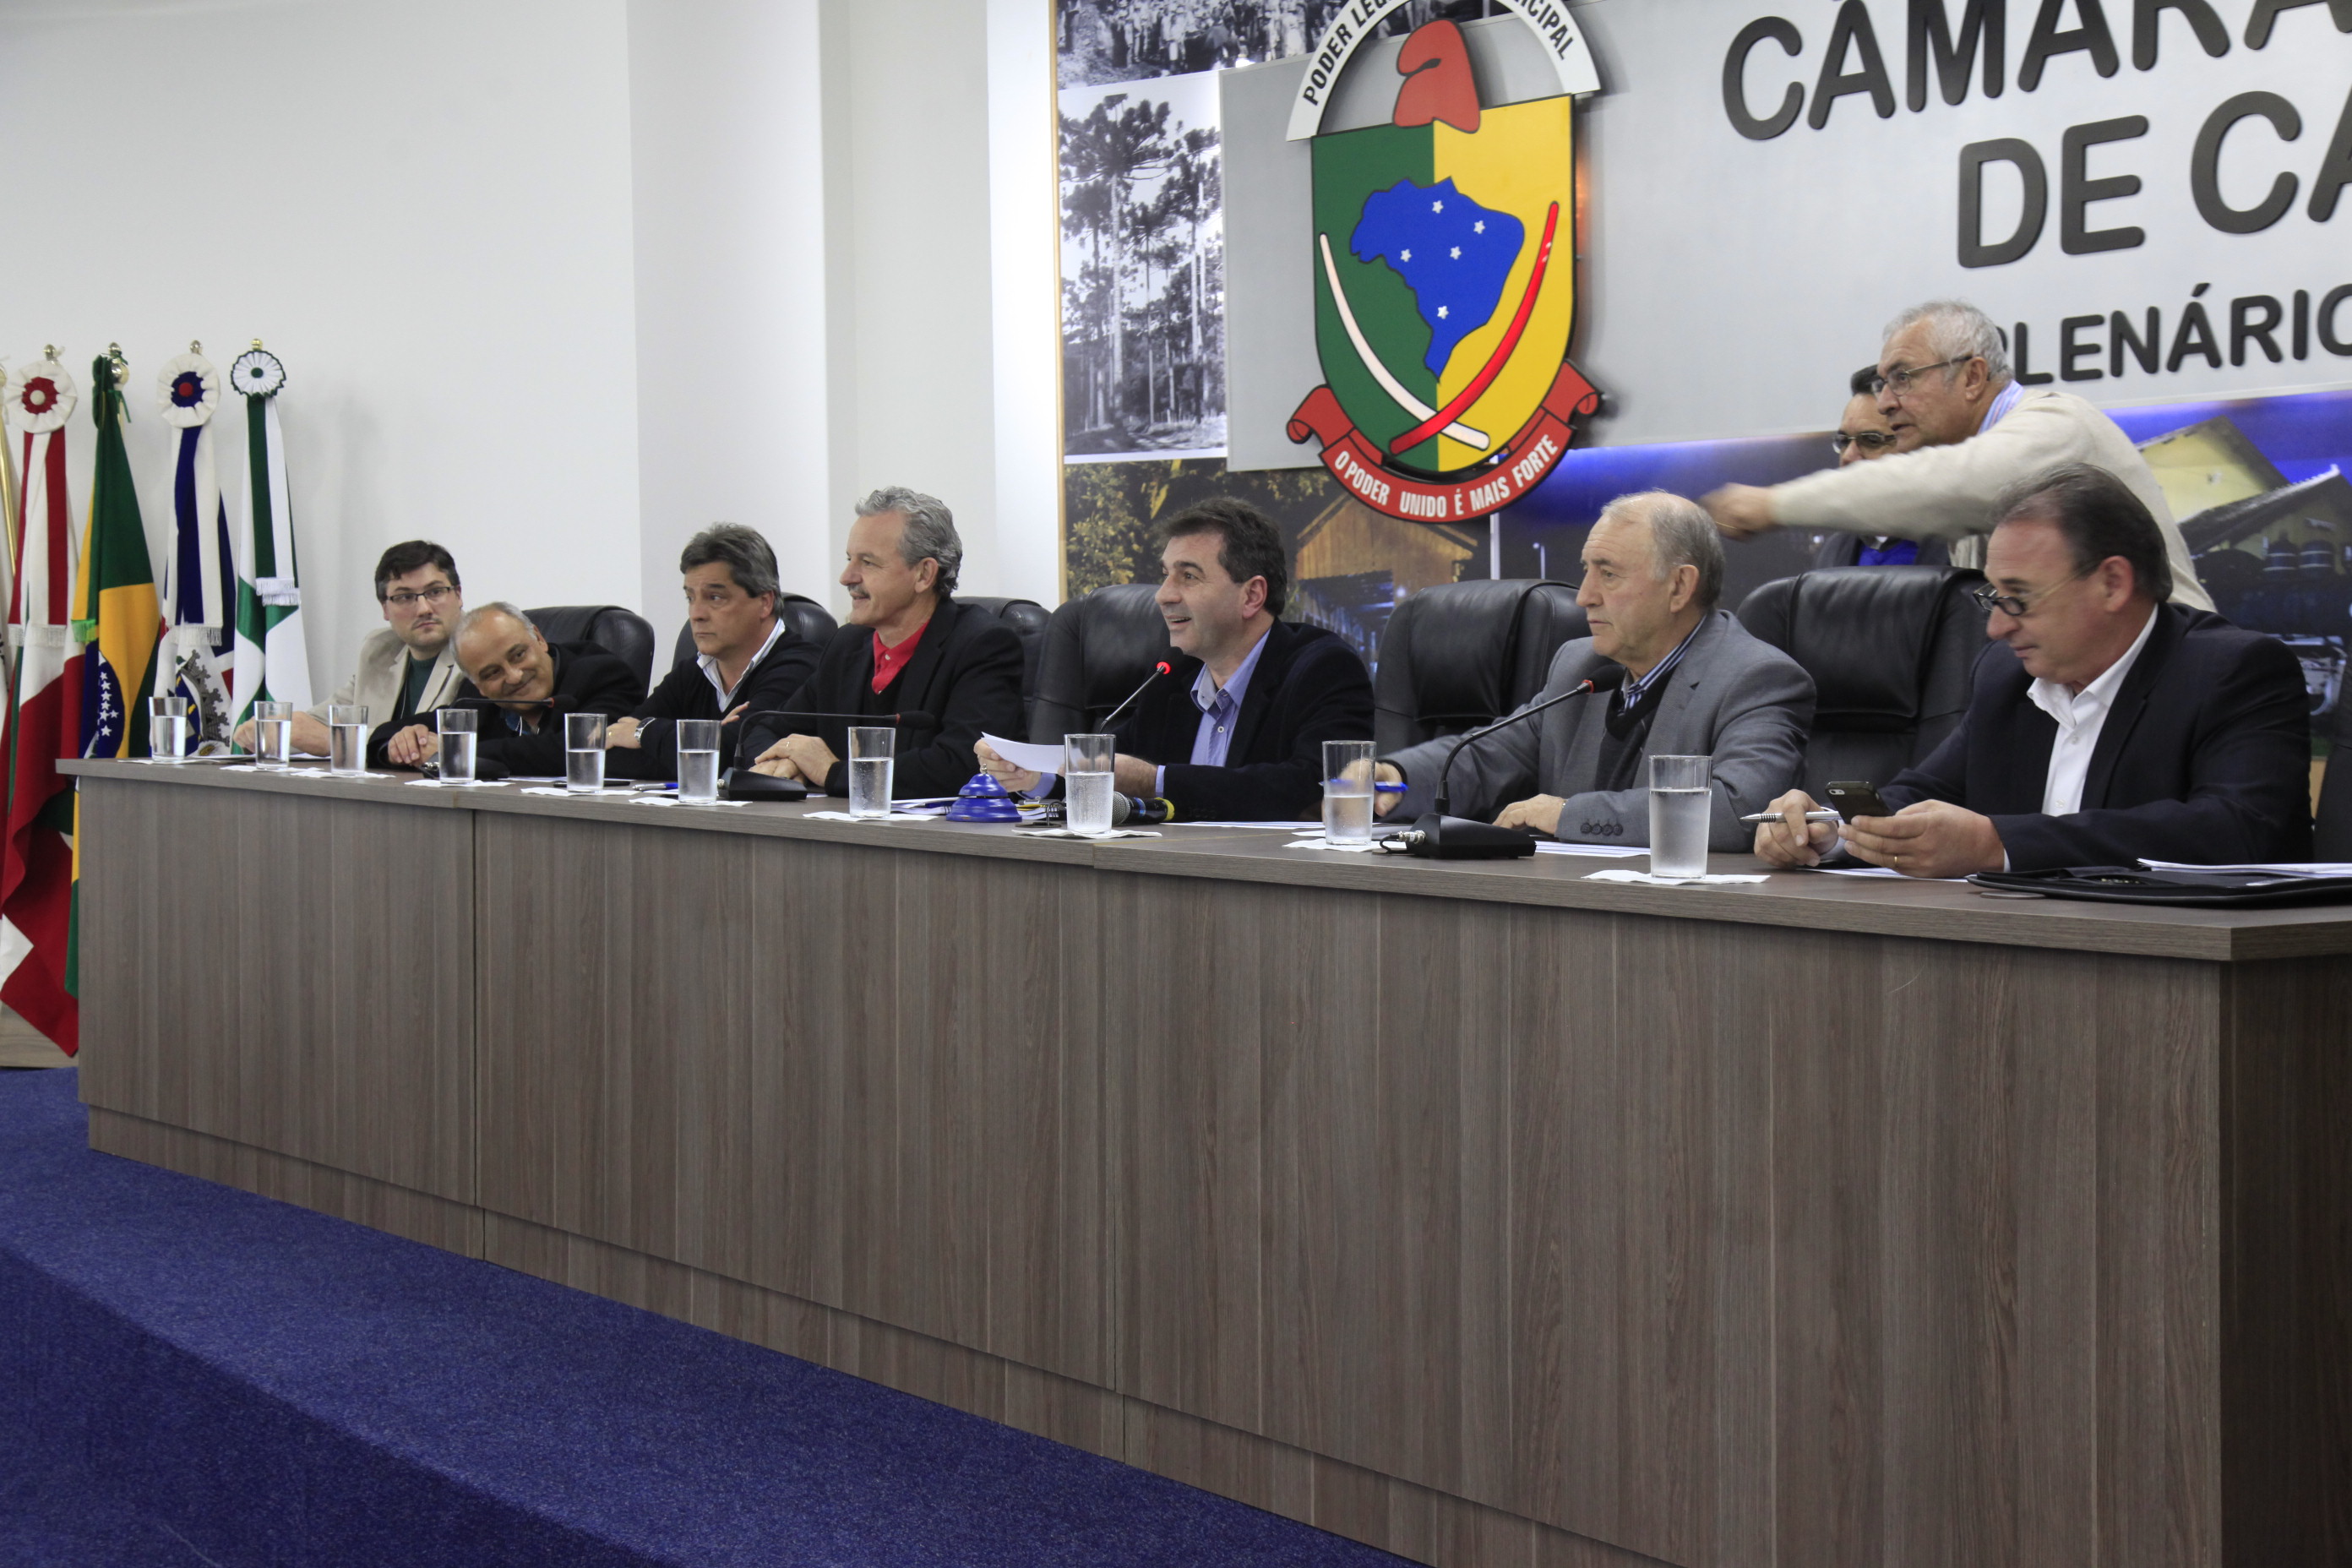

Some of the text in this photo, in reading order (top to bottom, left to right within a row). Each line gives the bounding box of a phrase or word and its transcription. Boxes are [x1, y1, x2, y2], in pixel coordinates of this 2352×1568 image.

[1303, 23, 1353, 106] PODER
[1957, 114, 2148, 269] DE
[1996, 283, 2352, 385] LENÁRIO
[1334, 433, 1559, 518] O PODER UNIDO É MAIS FORTE
